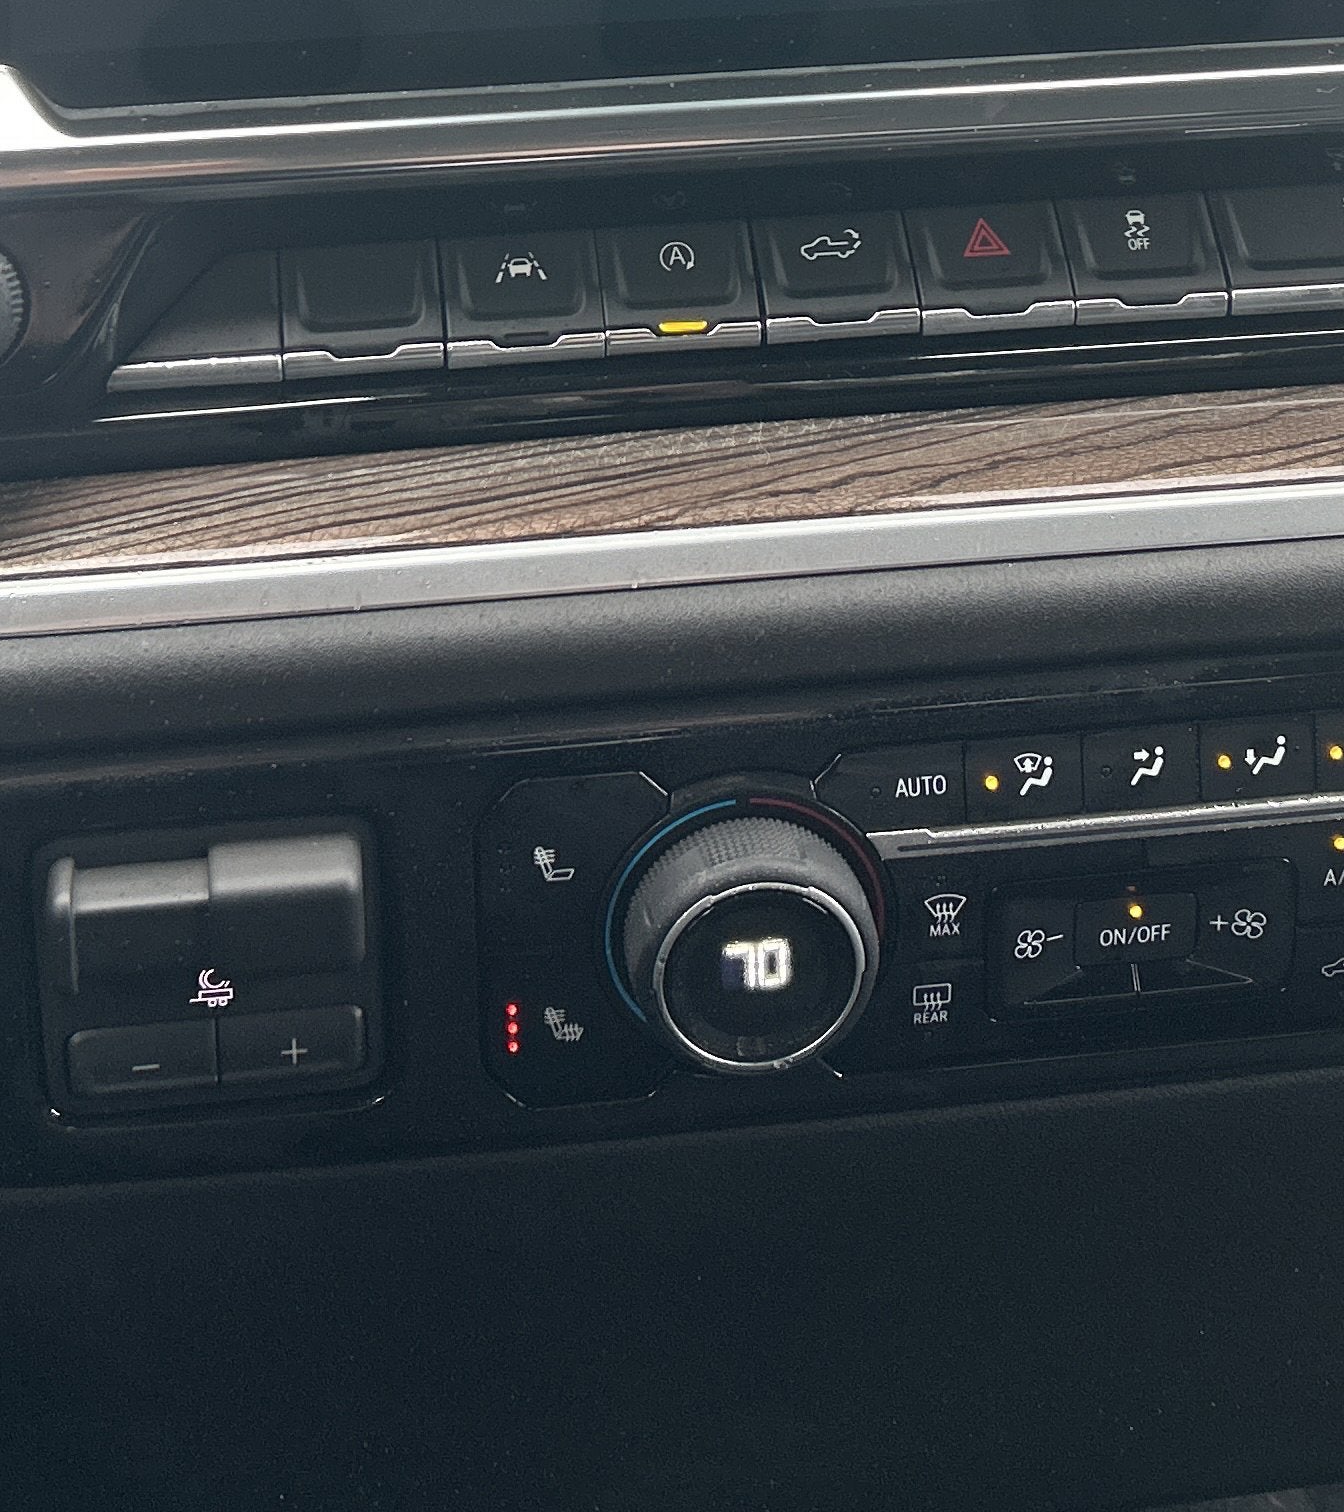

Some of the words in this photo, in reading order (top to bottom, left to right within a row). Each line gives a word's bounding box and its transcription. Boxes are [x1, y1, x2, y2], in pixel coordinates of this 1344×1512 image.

[1127, 237, 1151, 251] OFF
[895, 774, 947, 798] AUTO
[929, 922, 960, 938] MAX
[1099, 923, 1171, 947] ON/OFF
[721, 936, 792, 991] 70
[913, 1009, 948, 1025] REAR
